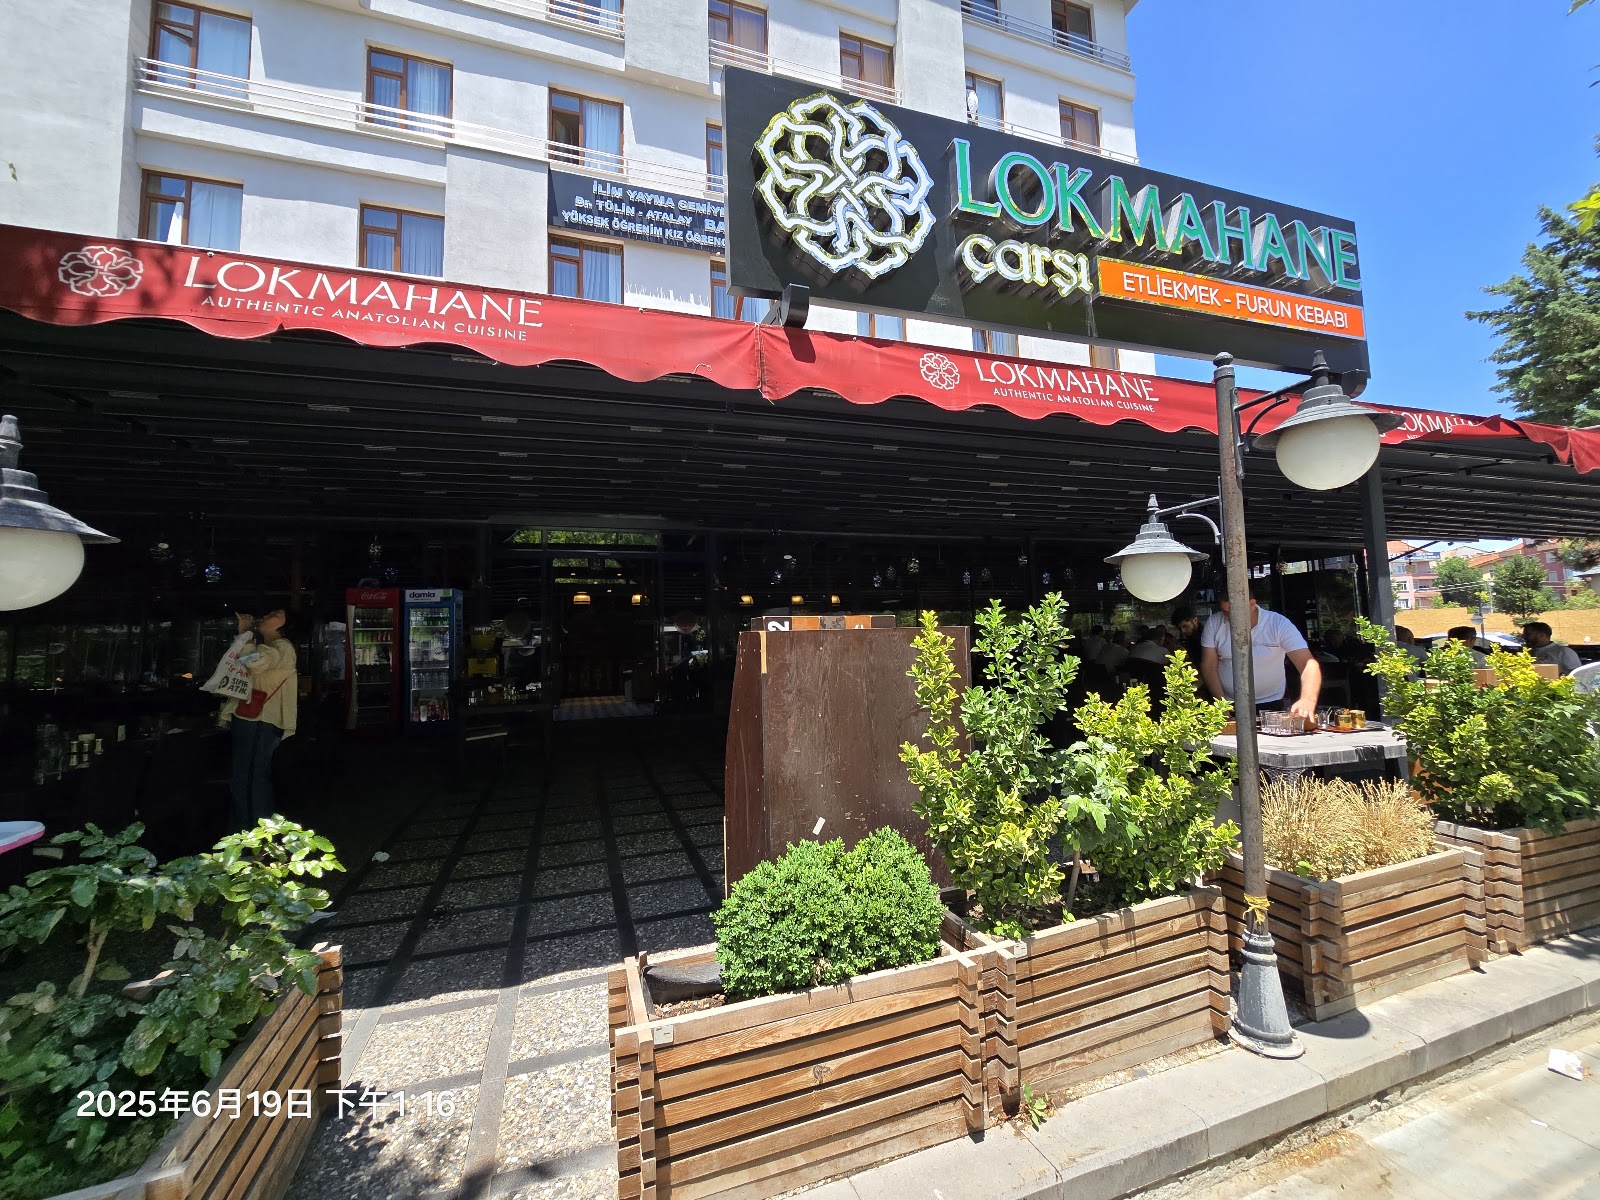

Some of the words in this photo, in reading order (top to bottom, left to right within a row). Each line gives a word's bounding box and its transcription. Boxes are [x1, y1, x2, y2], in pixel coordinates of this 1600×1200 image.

[626, 190, 675, 209] YAYMA
[645, 209, 693, 227] ATALAY
[952, 137, 1362, 291] LOKMAHANE
[562, 210, 610, 229] YÜKSEK
[611, 217, 663, 239] ÖĞRENİM
[665, 228, 684, 242] KIZ
[183, 255, 545, 329] LOKMAHANE
[1123, 272, 1221, 307] ETLİEKMEK
[1236, 293, 1292, 320] FURUN
[1295, 304, 1349, 330] KEBABI
[201, 294, 325, 318] AUTHENTIC
[331, 307, 446, 331] ANATOLIAN
[453, 322, 528, 342] CUISINE
[974, 358, 1160, 402] LOKMAHANE
[993, 387, 1054, 402] AUTHENTIC
[1057, 394, 1114, 408] ANATOLIAN
[1116, 400, 1156, 413] CUISINE
[409, 591, 436, 599] damla
